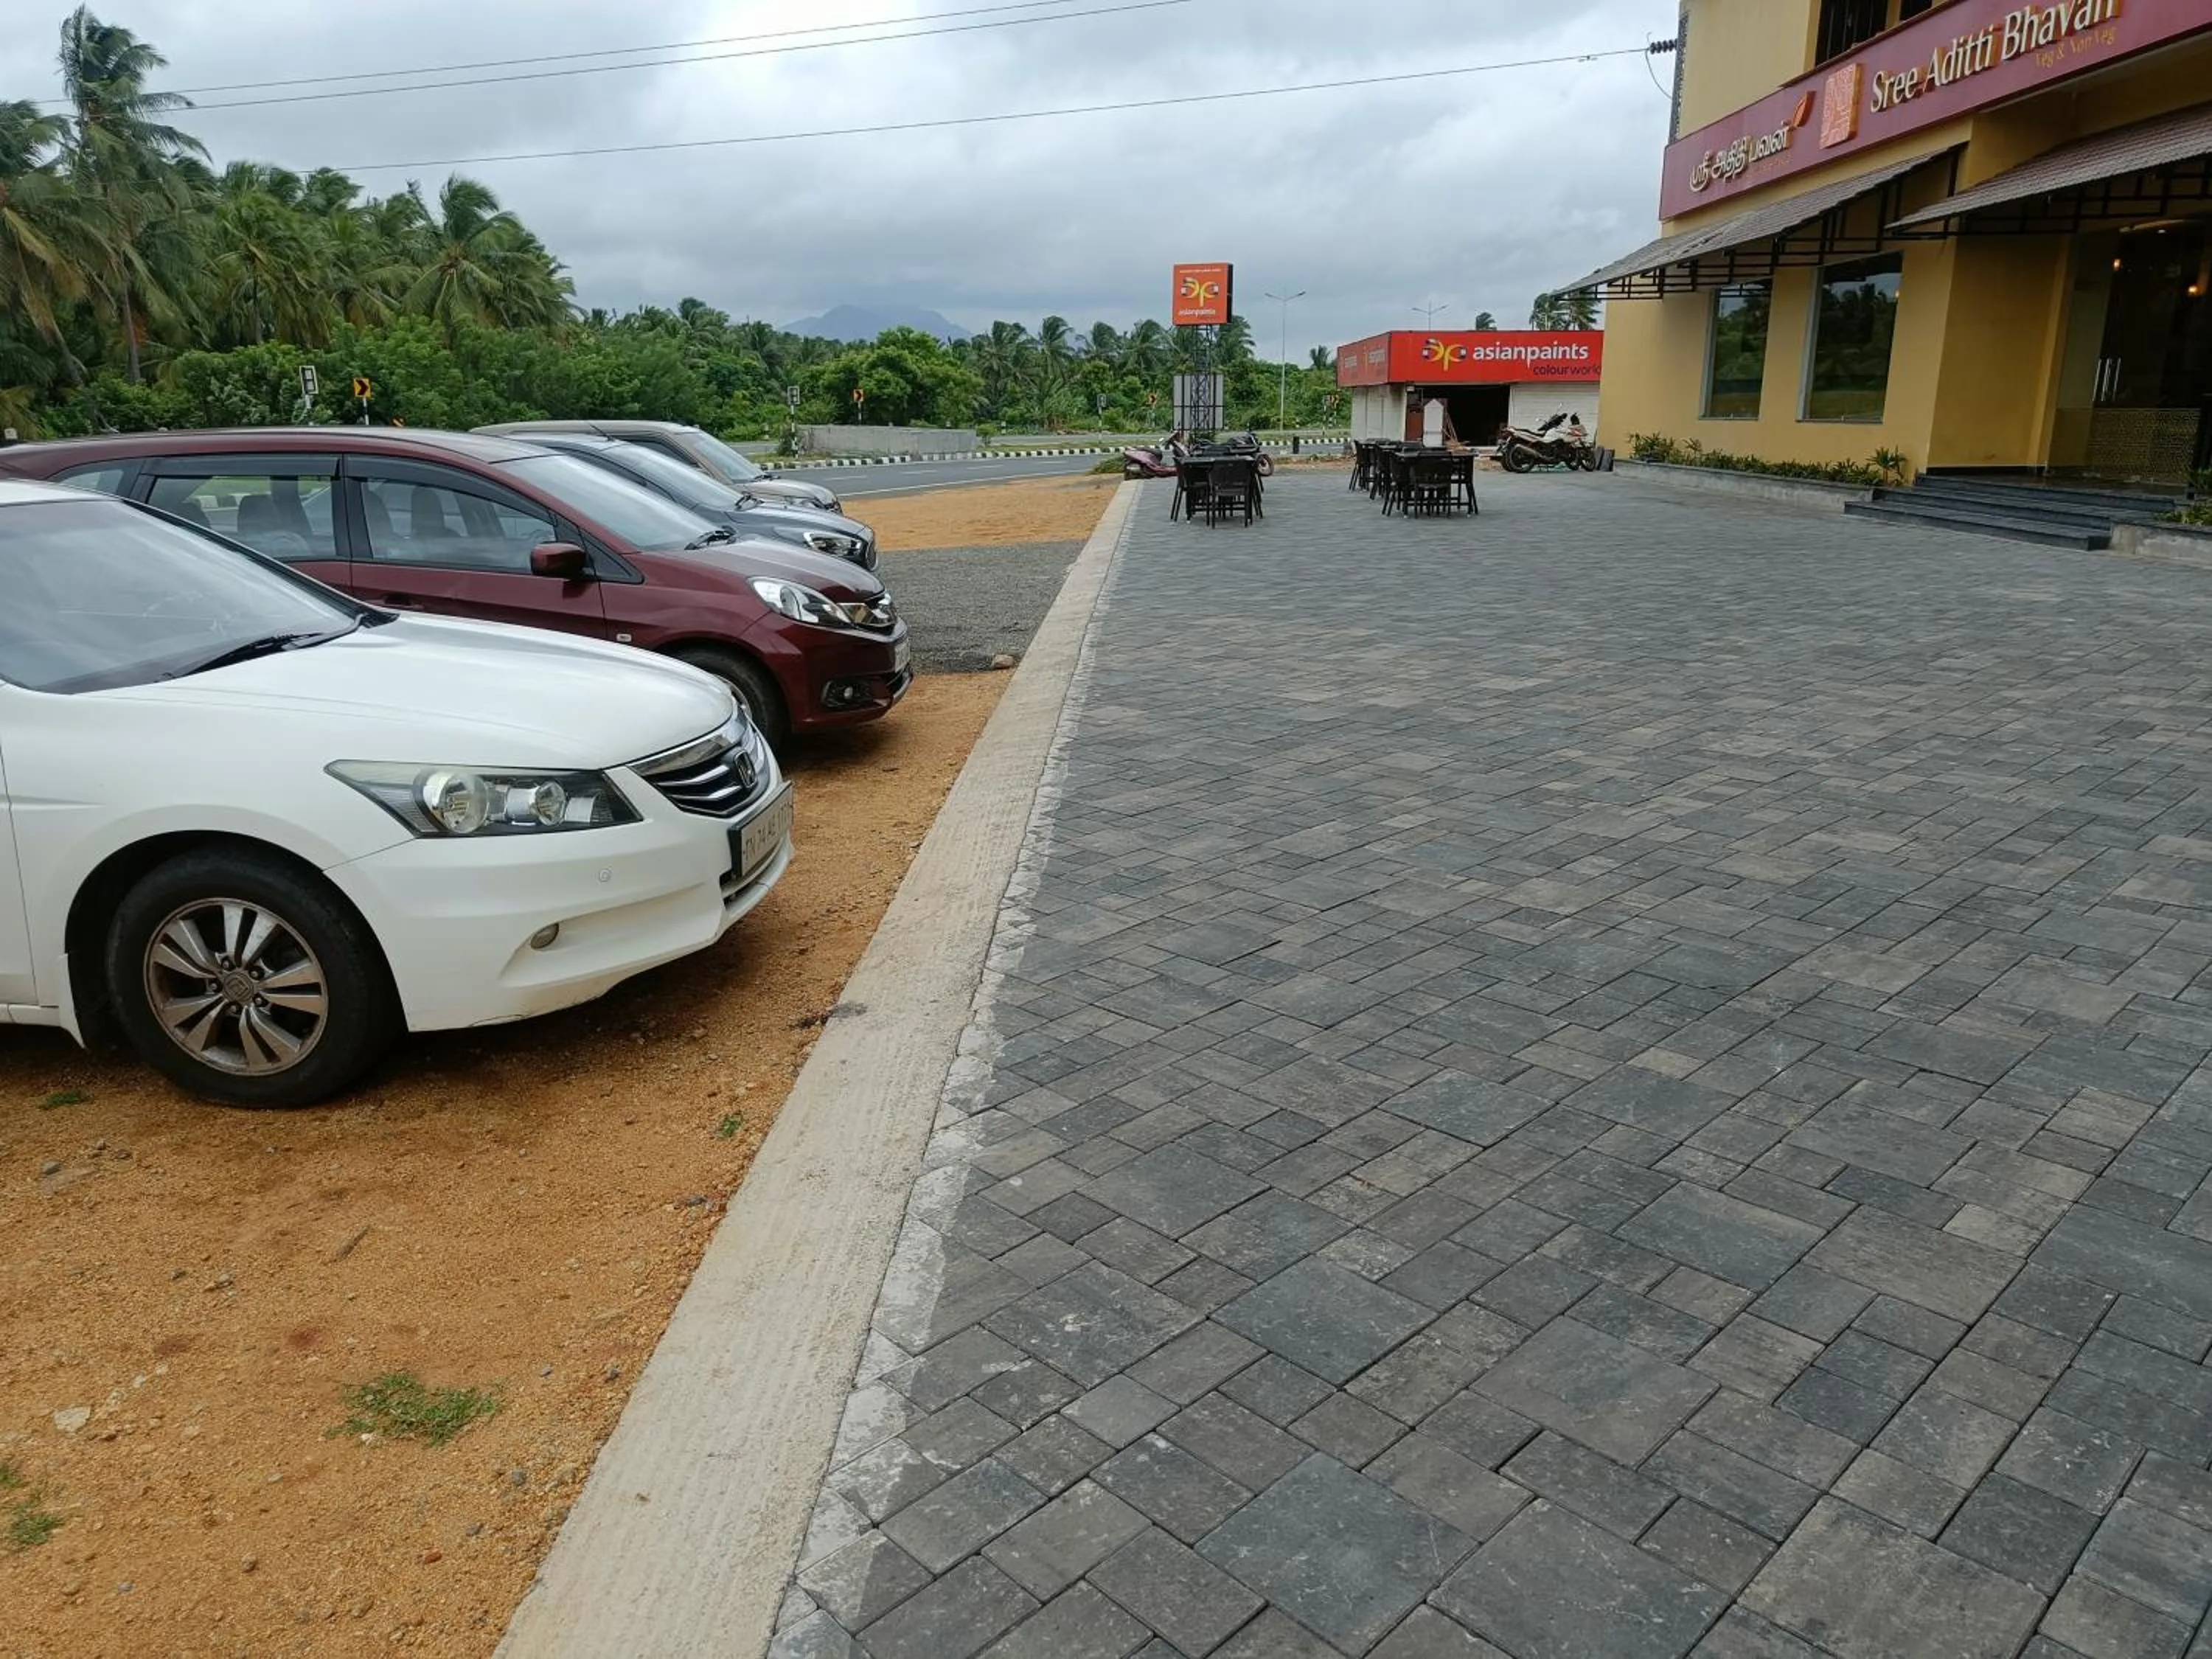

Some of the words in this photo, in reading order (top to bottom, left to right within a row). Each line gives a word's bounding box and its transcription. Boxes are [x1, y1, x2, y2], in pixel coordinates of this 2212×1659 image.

[1871, 67, 1919, 112] Sree
[1921, 24, 1994, 93] Aditti
[2000, 0, 2115, 61] Bhavan
[1748, 120, 1791, 163] பவன்
[1472, 340, 1589, 369] asianpaints
